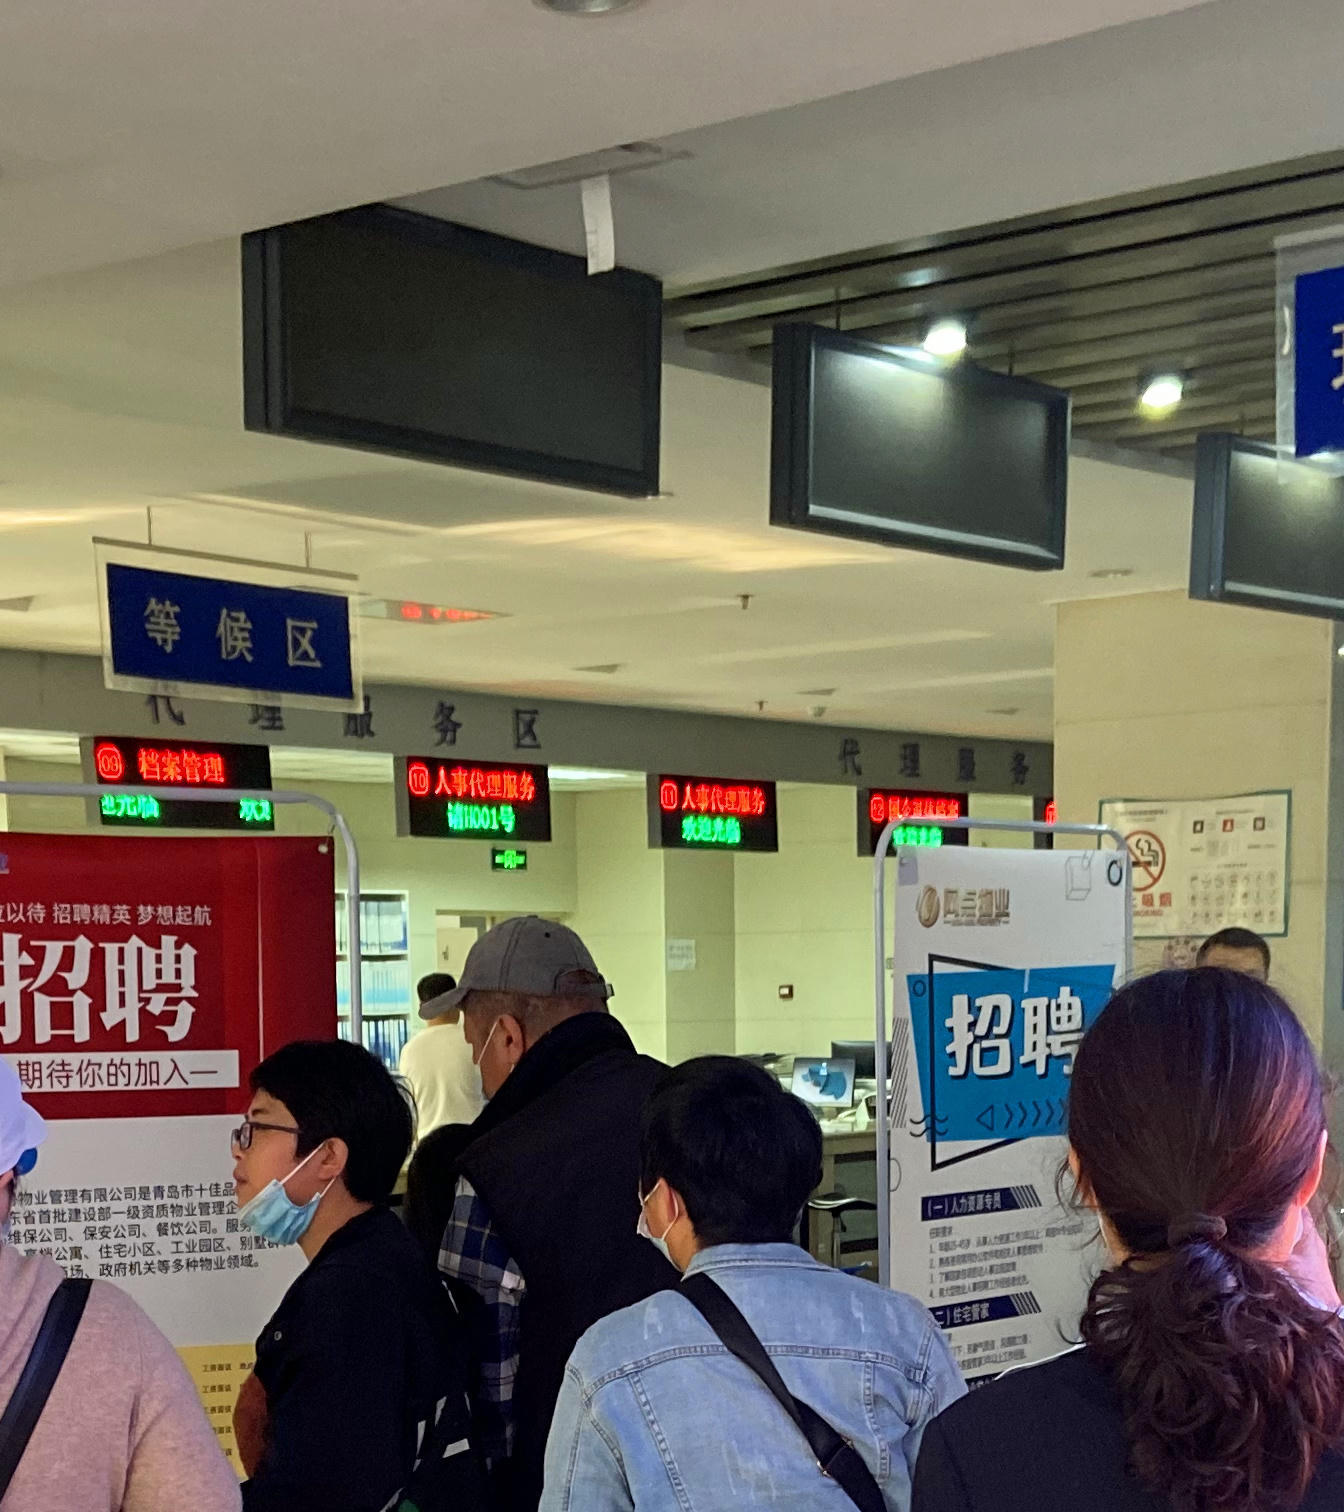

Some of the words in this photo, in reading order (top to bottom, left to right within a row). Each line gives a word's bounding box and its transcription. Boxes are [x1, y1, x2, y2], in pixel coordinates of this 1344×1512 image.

[143, 597, 322, 669] 等候区
[138, 748, 224, 783] 档案管理
[435, 766, 535, 800] 人事代理服务
[682, 783, 765, 816] 人事代理服务
[682, 815, 740, 844] 欢迎光临
[52, 902, 133, 926] 招聘精英
[136, 903, 212, 927] 梦想起航
[945, 986, 1086, 1081] 招聘
[13, 1182, 236, 1207] 物业管理有限公司是青岛市十佳品
